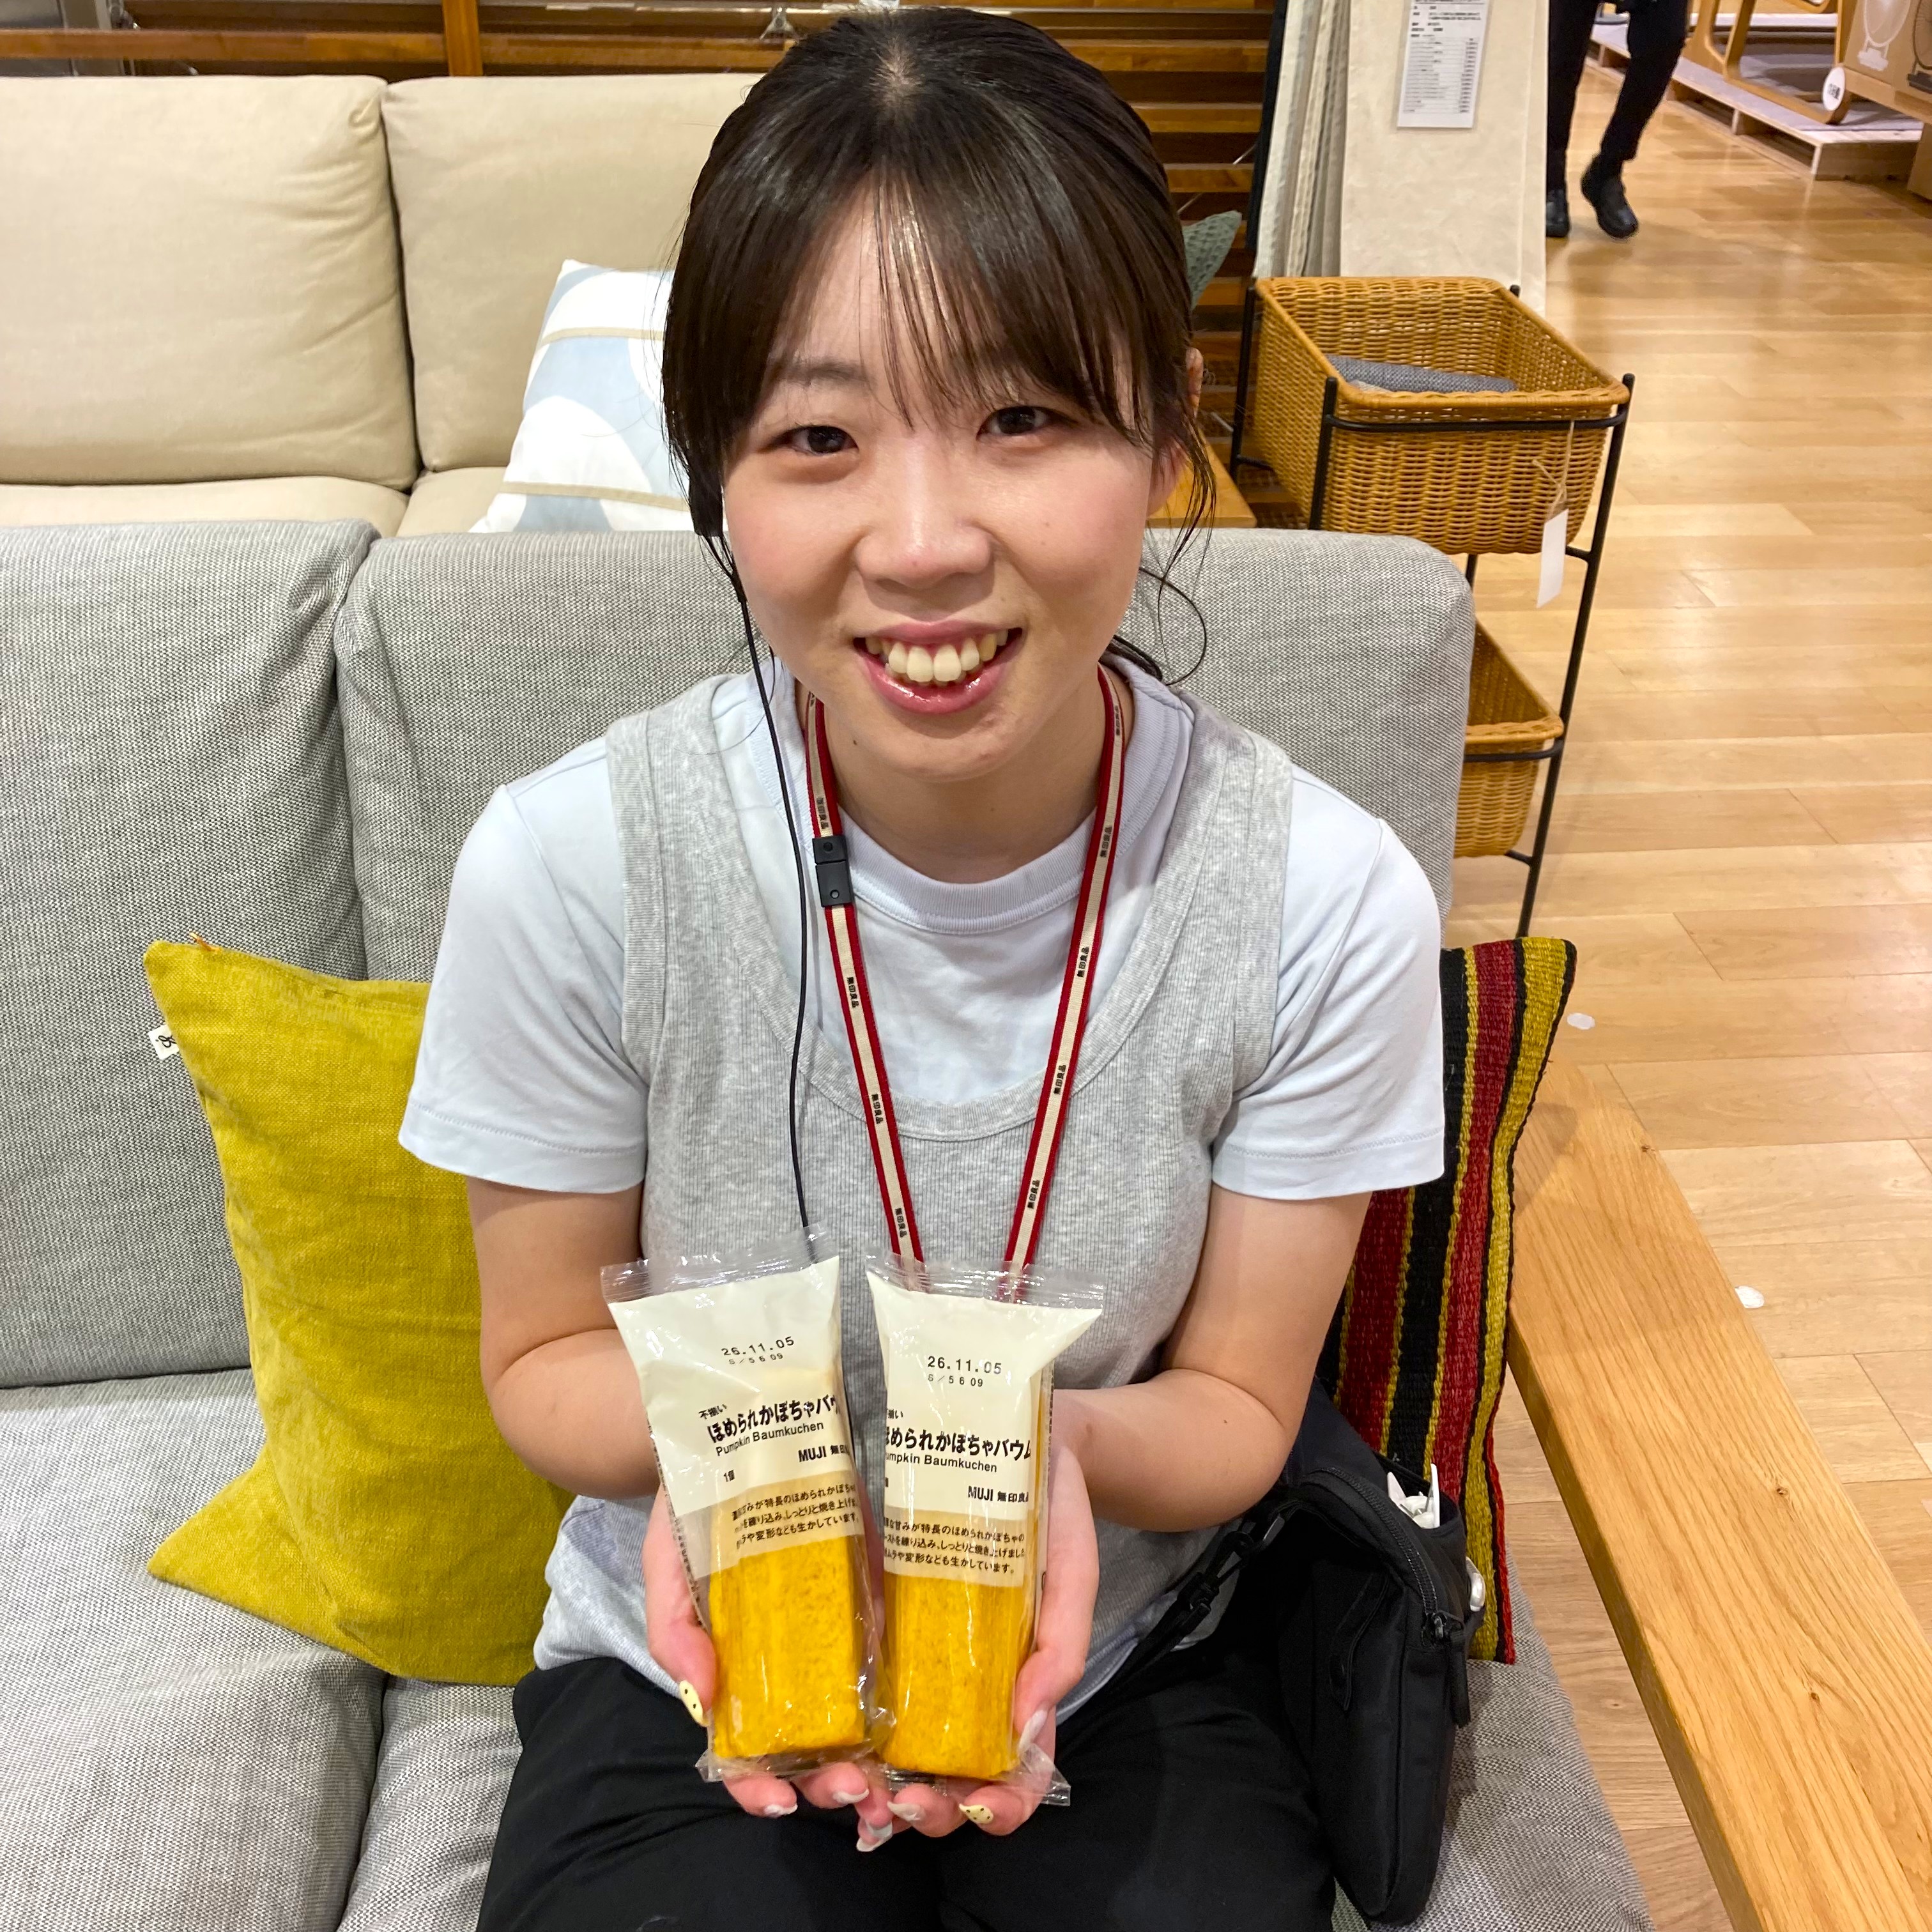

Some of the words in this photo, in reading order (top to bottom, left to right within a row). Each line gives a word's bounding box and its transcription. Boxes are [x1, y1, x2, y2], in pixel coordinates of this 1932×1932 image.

[721, 1336, 795, 1356] 26.11.05
[928, 1355, 1002, 1374] 26.11.05
[716, 1435, 751, 1457] Pumpkin
[753, 1422, 824, 1442] Baumkuchen
[798, 1446, 827, 1462] MUJI
[924, 1454, 998, 1473] Baumkuchen
[968, 1485, 993, 1501] MUJI
